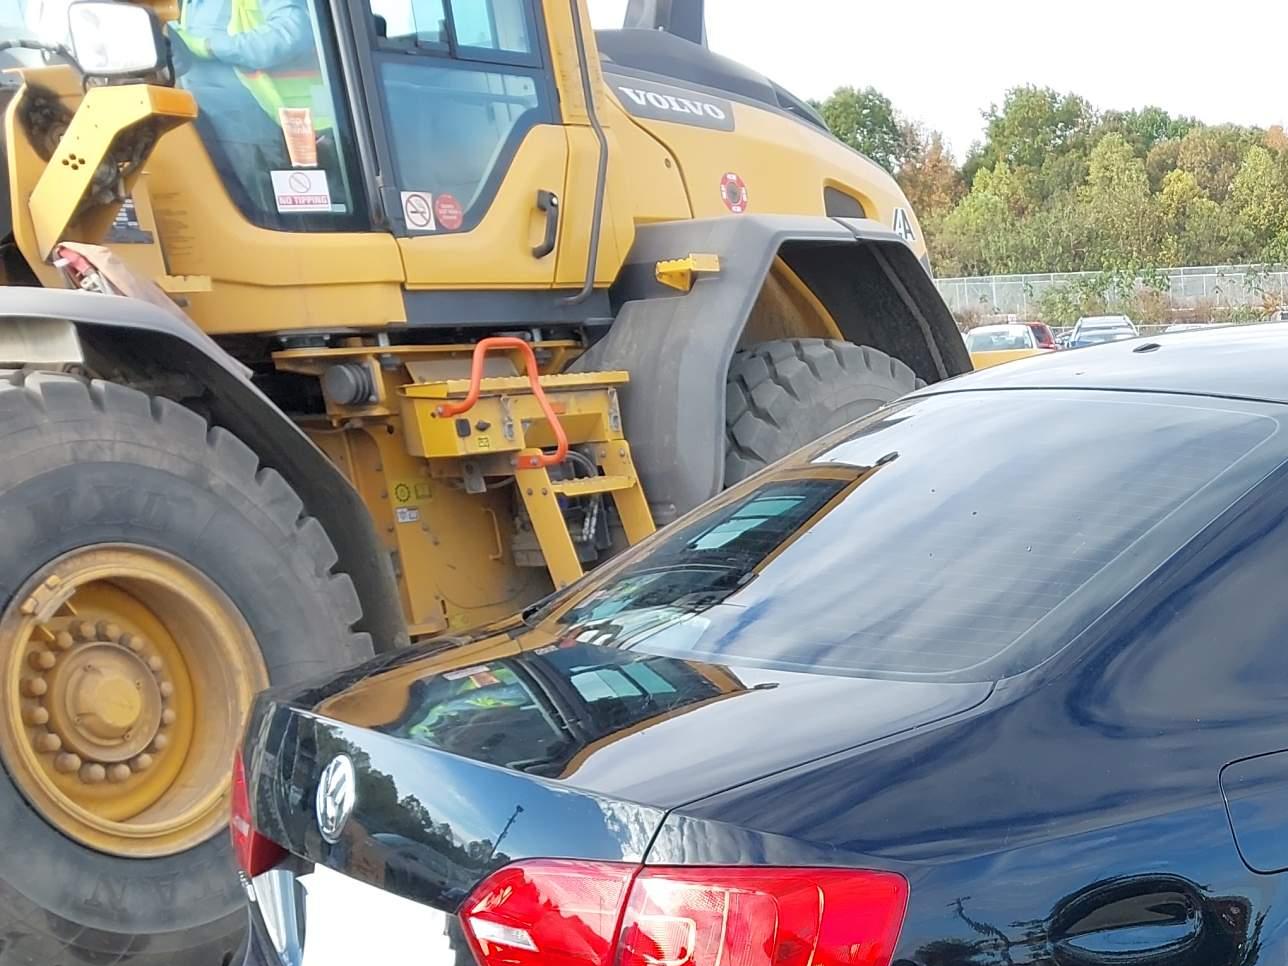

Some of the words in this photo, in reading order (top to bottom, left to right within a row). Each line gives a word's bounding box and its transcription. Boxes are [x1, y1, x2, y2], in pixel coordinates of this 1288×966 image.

[618, 86, 726, 120] VOLVO
[279, 195, 292, 205] NO
[293, 195, 328, 205] TIPPING
